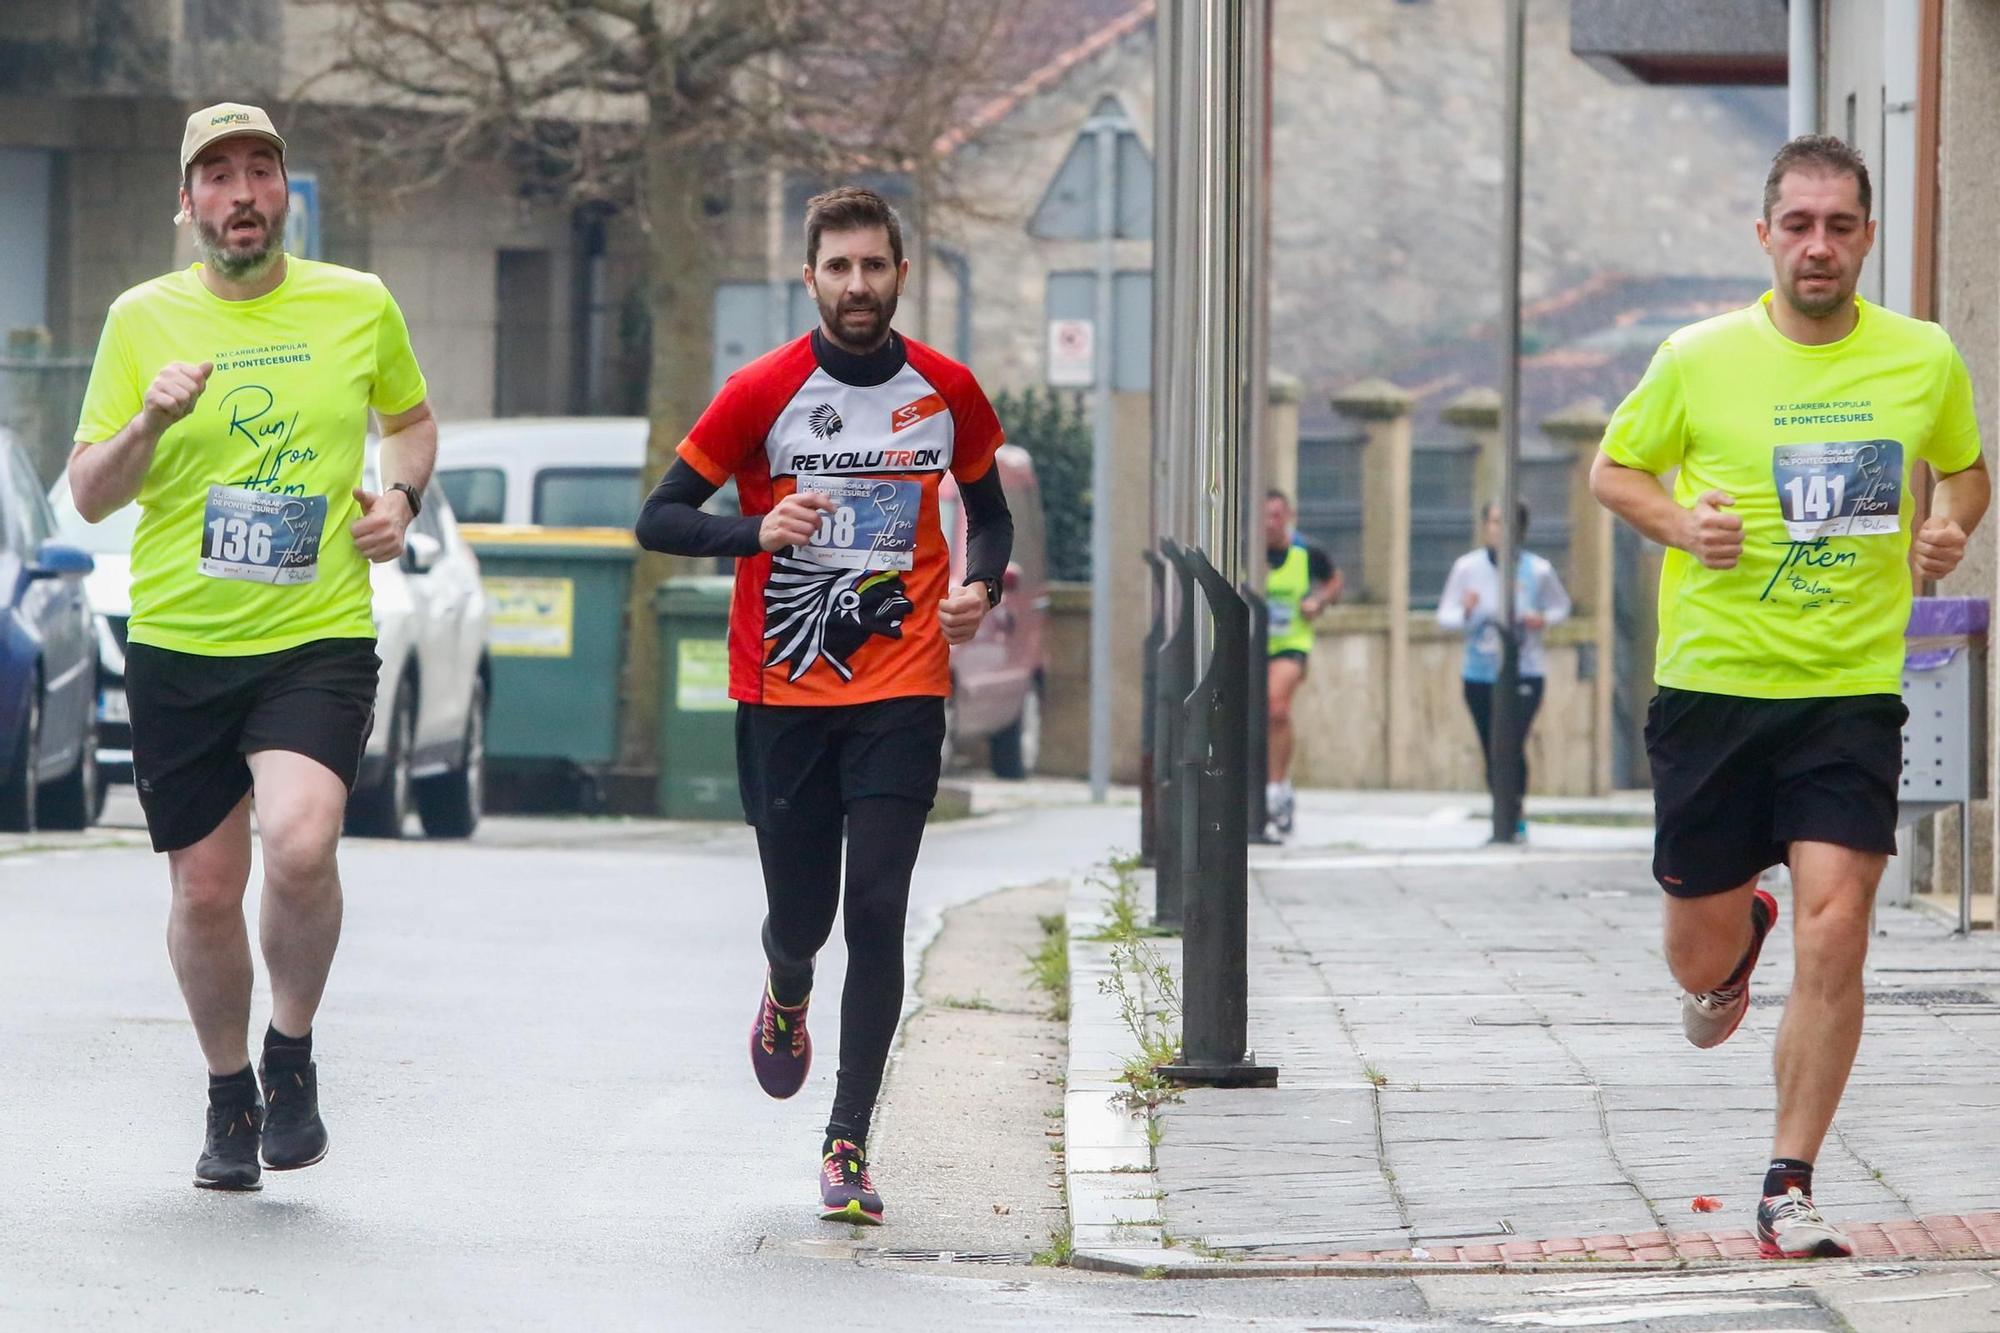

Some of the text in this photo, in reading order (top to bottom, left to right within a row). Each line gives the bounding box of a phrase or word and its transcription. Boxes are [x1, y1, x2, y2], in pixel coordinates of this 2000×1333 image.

[271, 342, 308, 353] POPULAR
[216, 353, 311, 371] DE PONTECESURES
[219, 385, 285, 448] Run
[1789, 402, 1831, 411] CARREIRA
[1832, 400, 1872, 410] POPULAR
[1774, 413, 1874, 426] DE PONTECESURES
[791, 449, 941, 471] REVOLUTRION
[872, 482, 899, 517] Run
[1784, 474, 1846, 521] 141
[208, 516, 273, 565] 136
